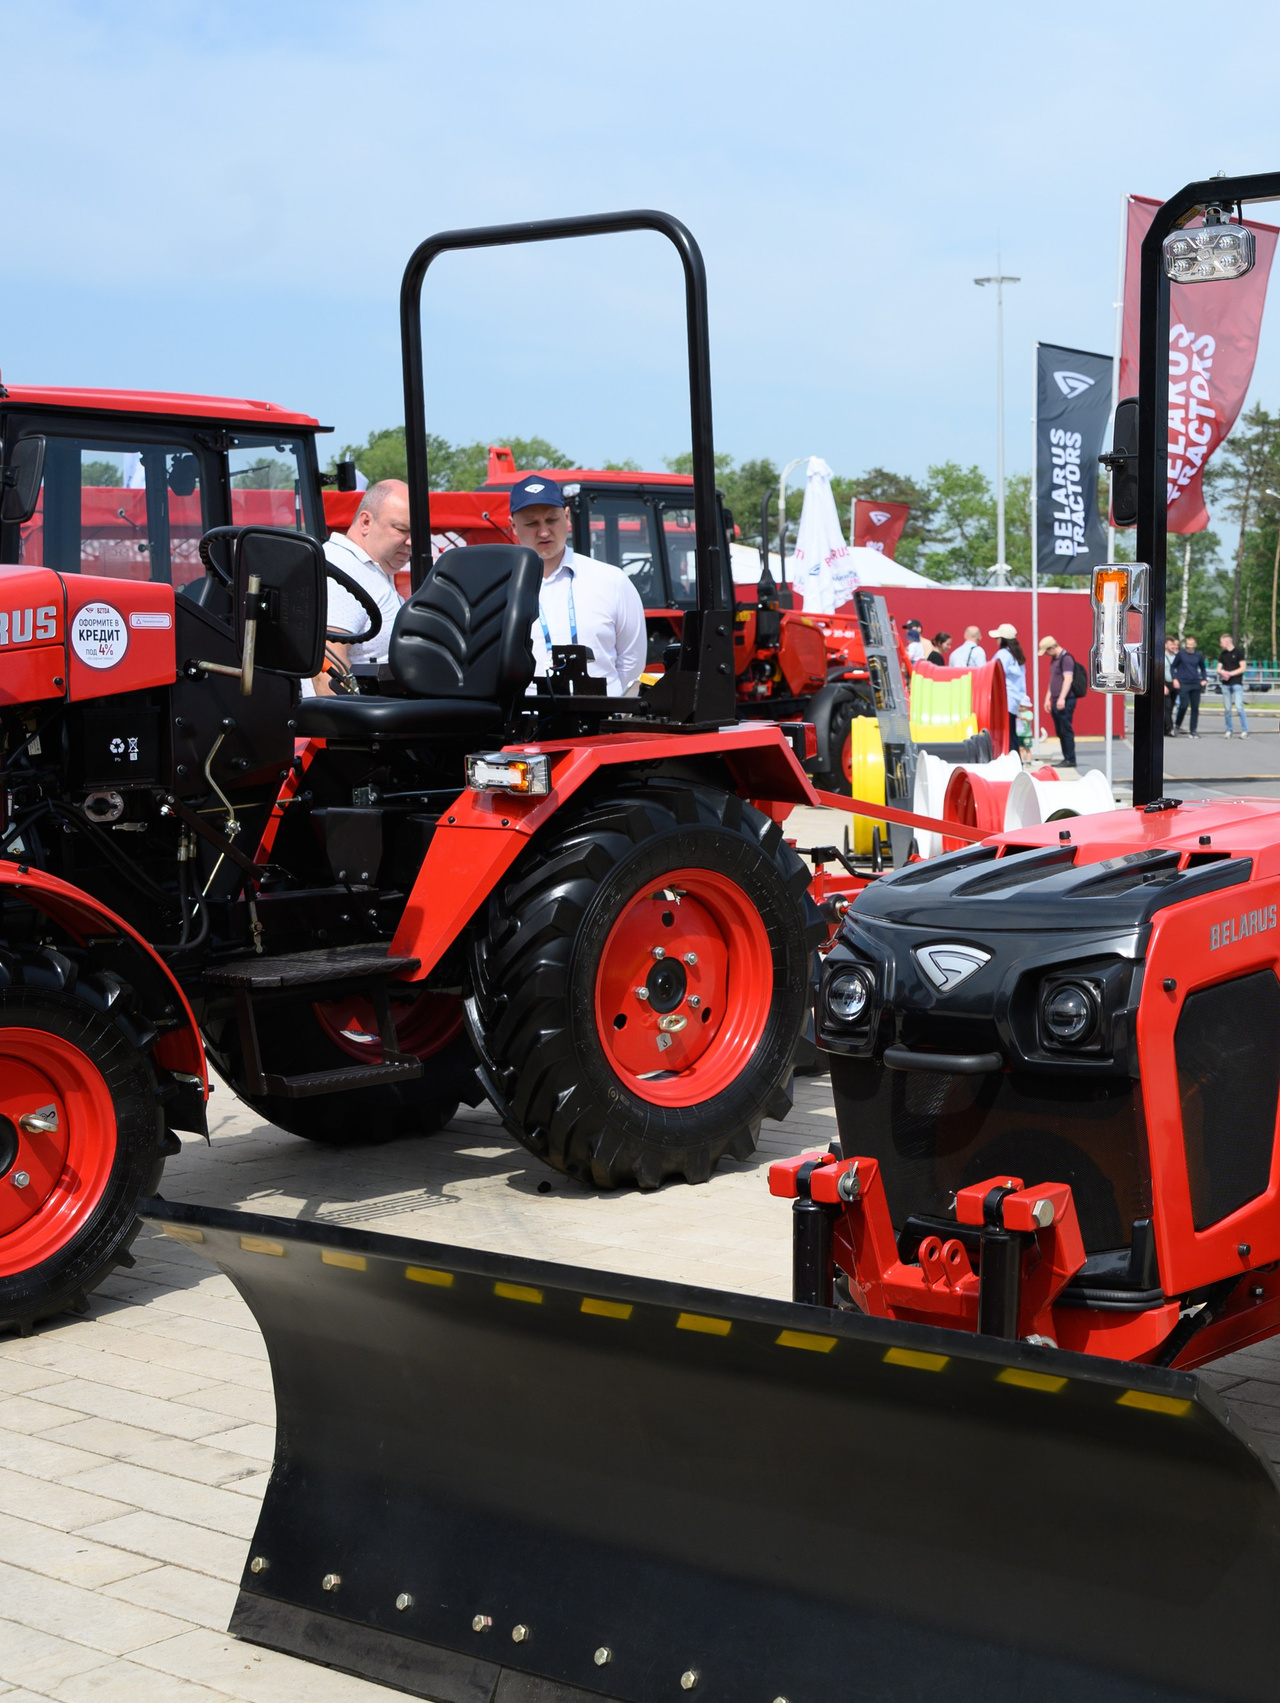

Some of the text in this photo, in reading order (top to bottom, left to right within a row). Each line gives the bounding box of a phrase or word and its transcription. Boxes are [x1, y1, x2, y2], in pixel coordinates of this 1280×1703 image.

[1050, 427, 1075, 556] BELARUS
[1064, 430, 1090, 557] TRACTORS
[78, 618, 120, 627] ОФОРМИТЕ В
[78, 629, 120, 643] КРЕДИТ
[99, 643, 114, 656] 4%
[1209, 903, 1278, 952] BELARUS
